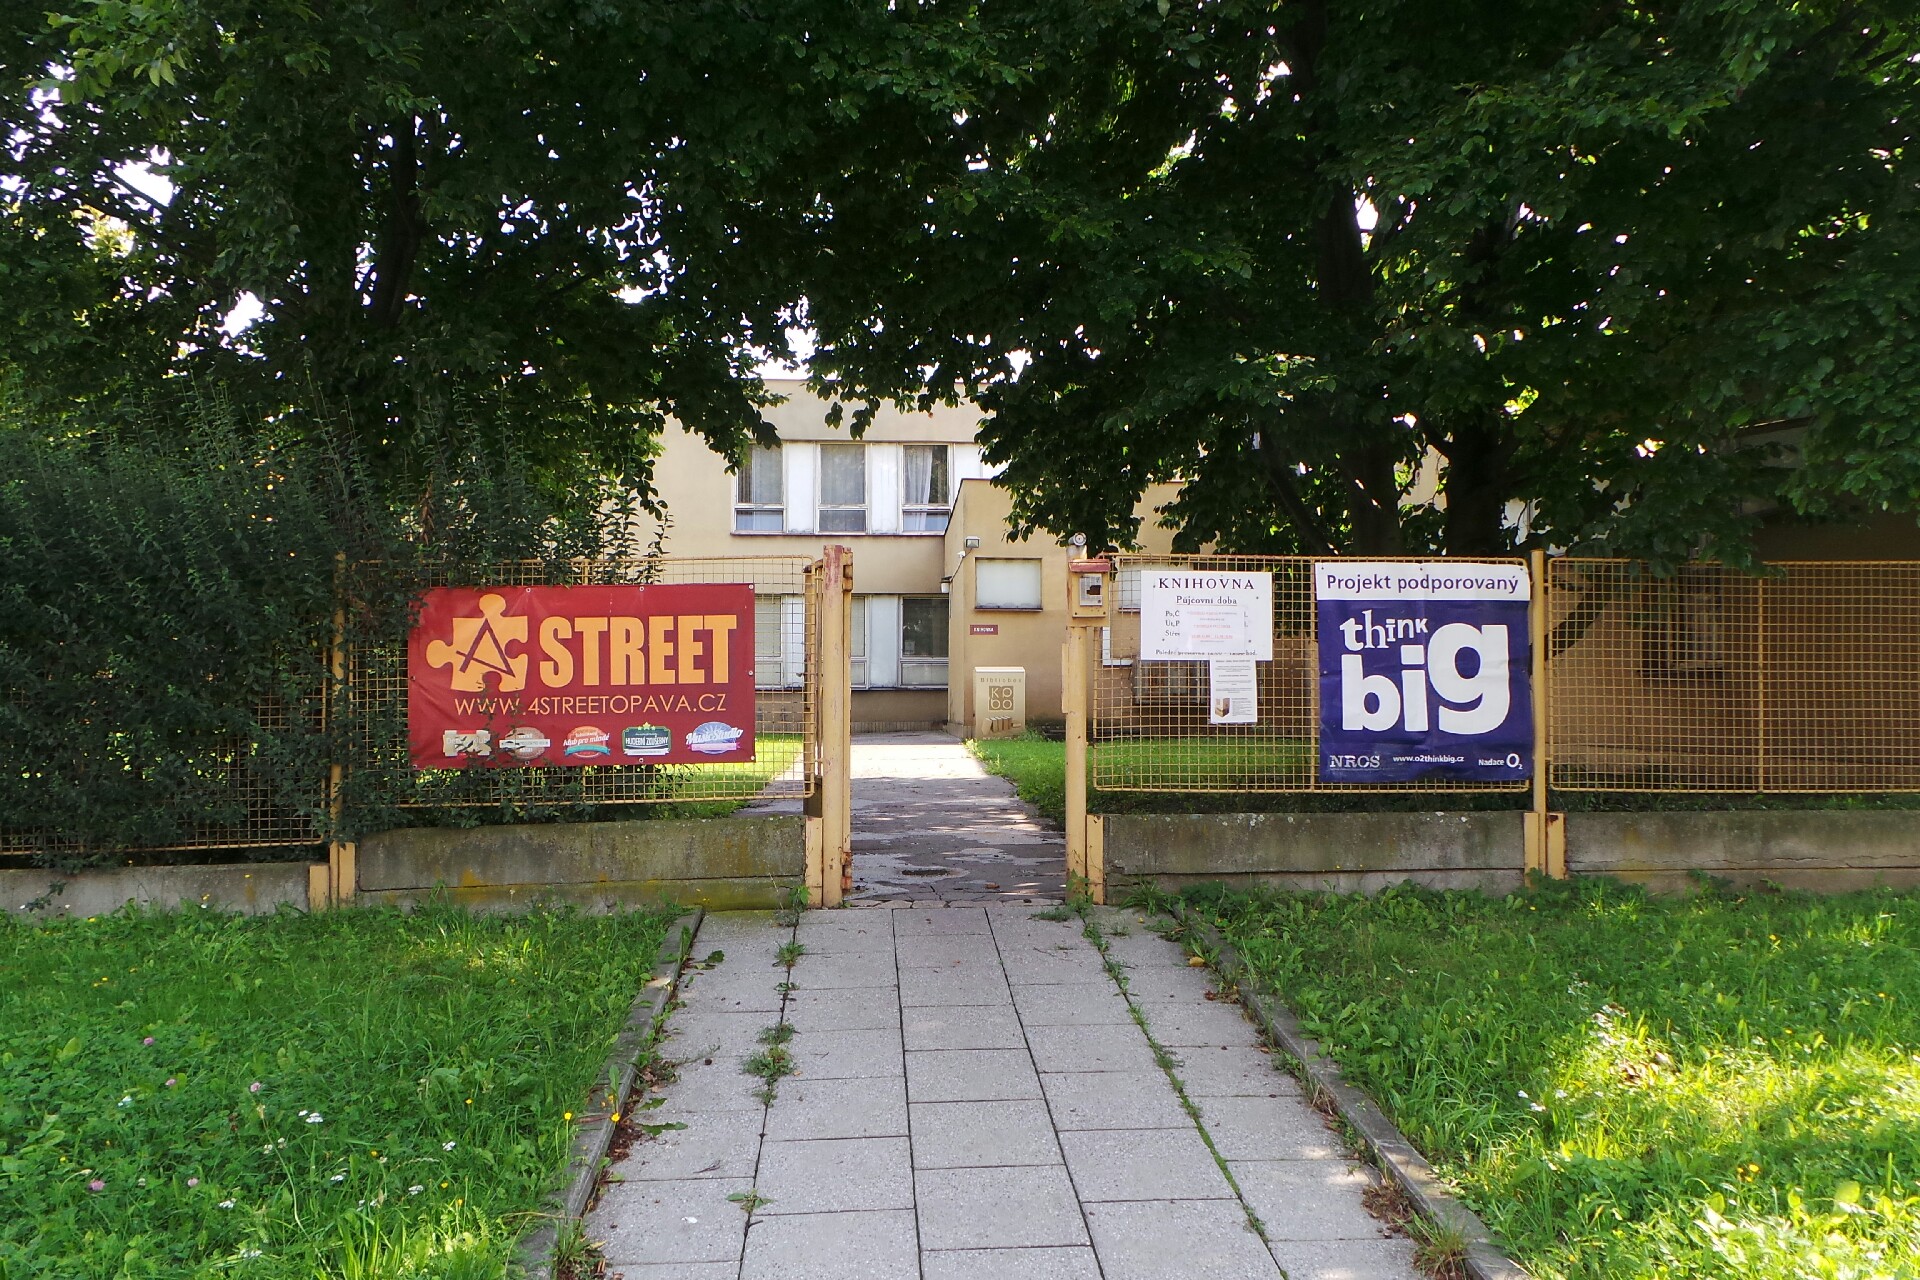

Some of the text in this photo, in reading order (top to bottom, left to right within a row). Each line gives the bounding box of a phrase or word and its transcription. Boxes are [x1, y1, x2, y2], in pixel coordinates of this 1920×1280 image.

[1159, 577, 1254, 590] KNIHOVNA
[1327, 574, 1518, 594] Projekt podporovaný
[1217, 596, 1237, 605] doba
[1339, 609, 1428, 651] think
[539, 614, 737, 688] STREET
[1341, 622, 1510, 735] big
[454, 693, 727, 716] WWW.4STREETOPAVA.CZ
[1393, 754, 1465, 763] www.o2thinkbig.cz
